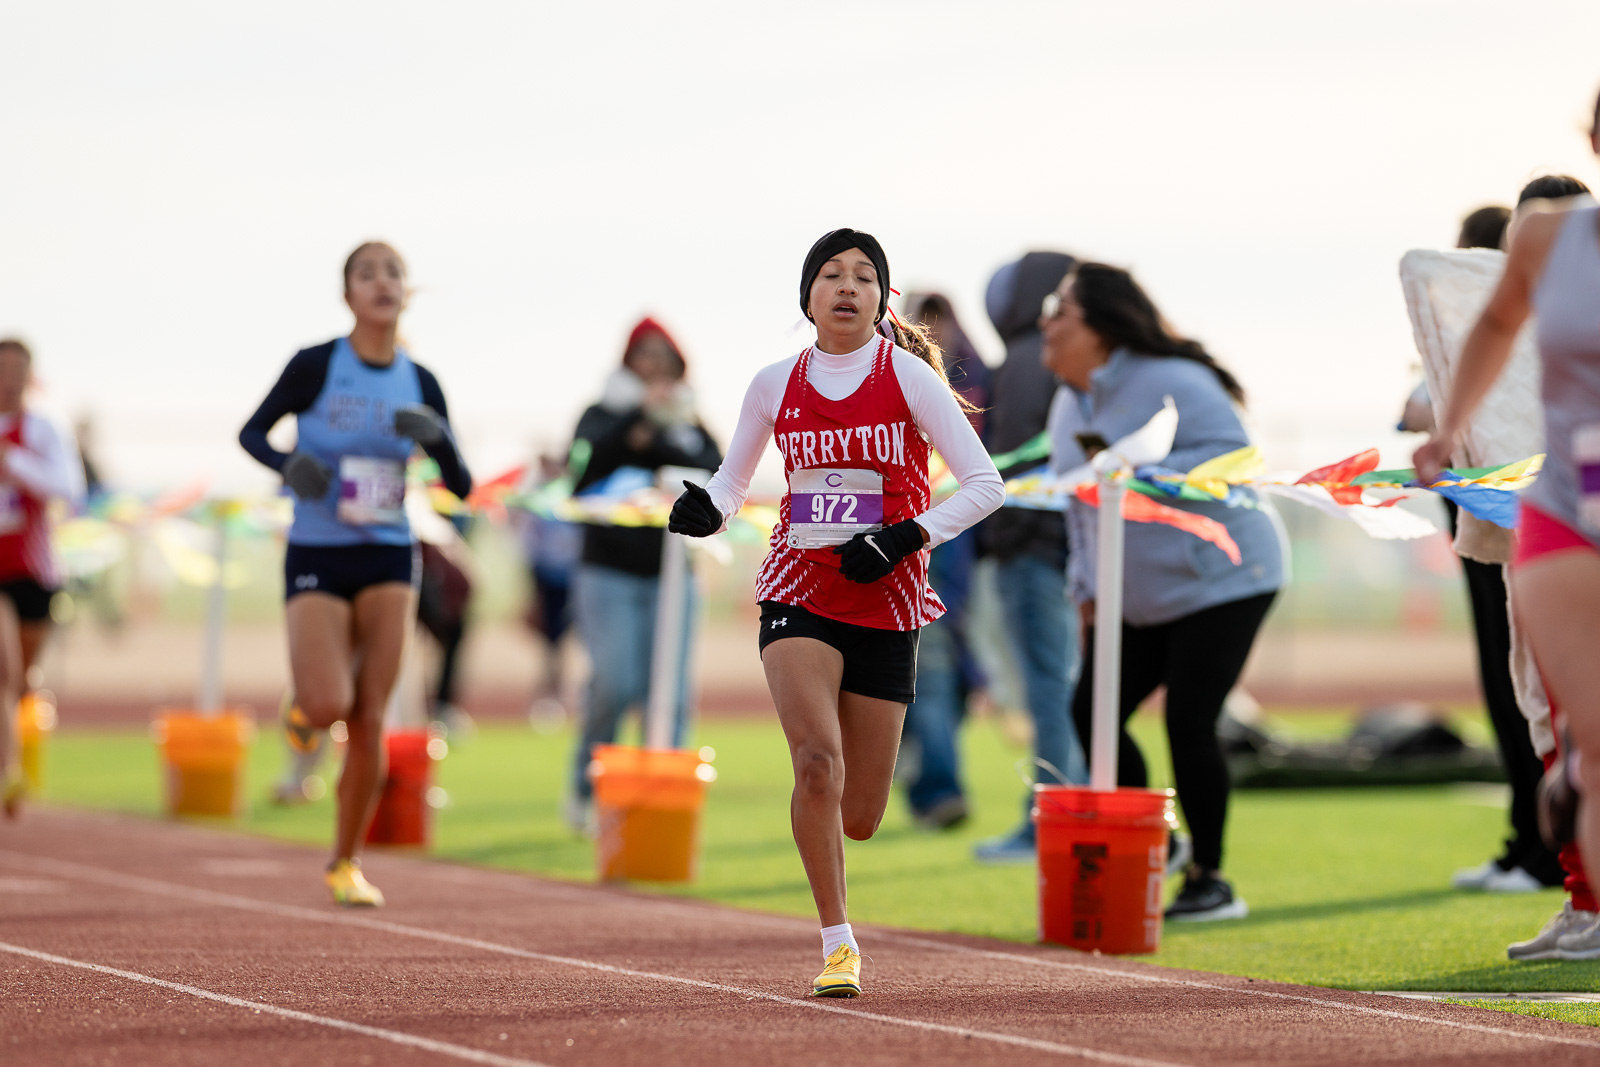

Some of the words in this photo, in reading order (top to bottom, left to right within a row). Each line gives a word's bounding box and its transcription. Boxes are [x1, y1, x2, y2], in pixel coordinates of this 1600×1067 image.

[778, 421, 906, 469] PERRYTON
[825, 473, 843, 488] C
[811, 494, 858, 523] 972
